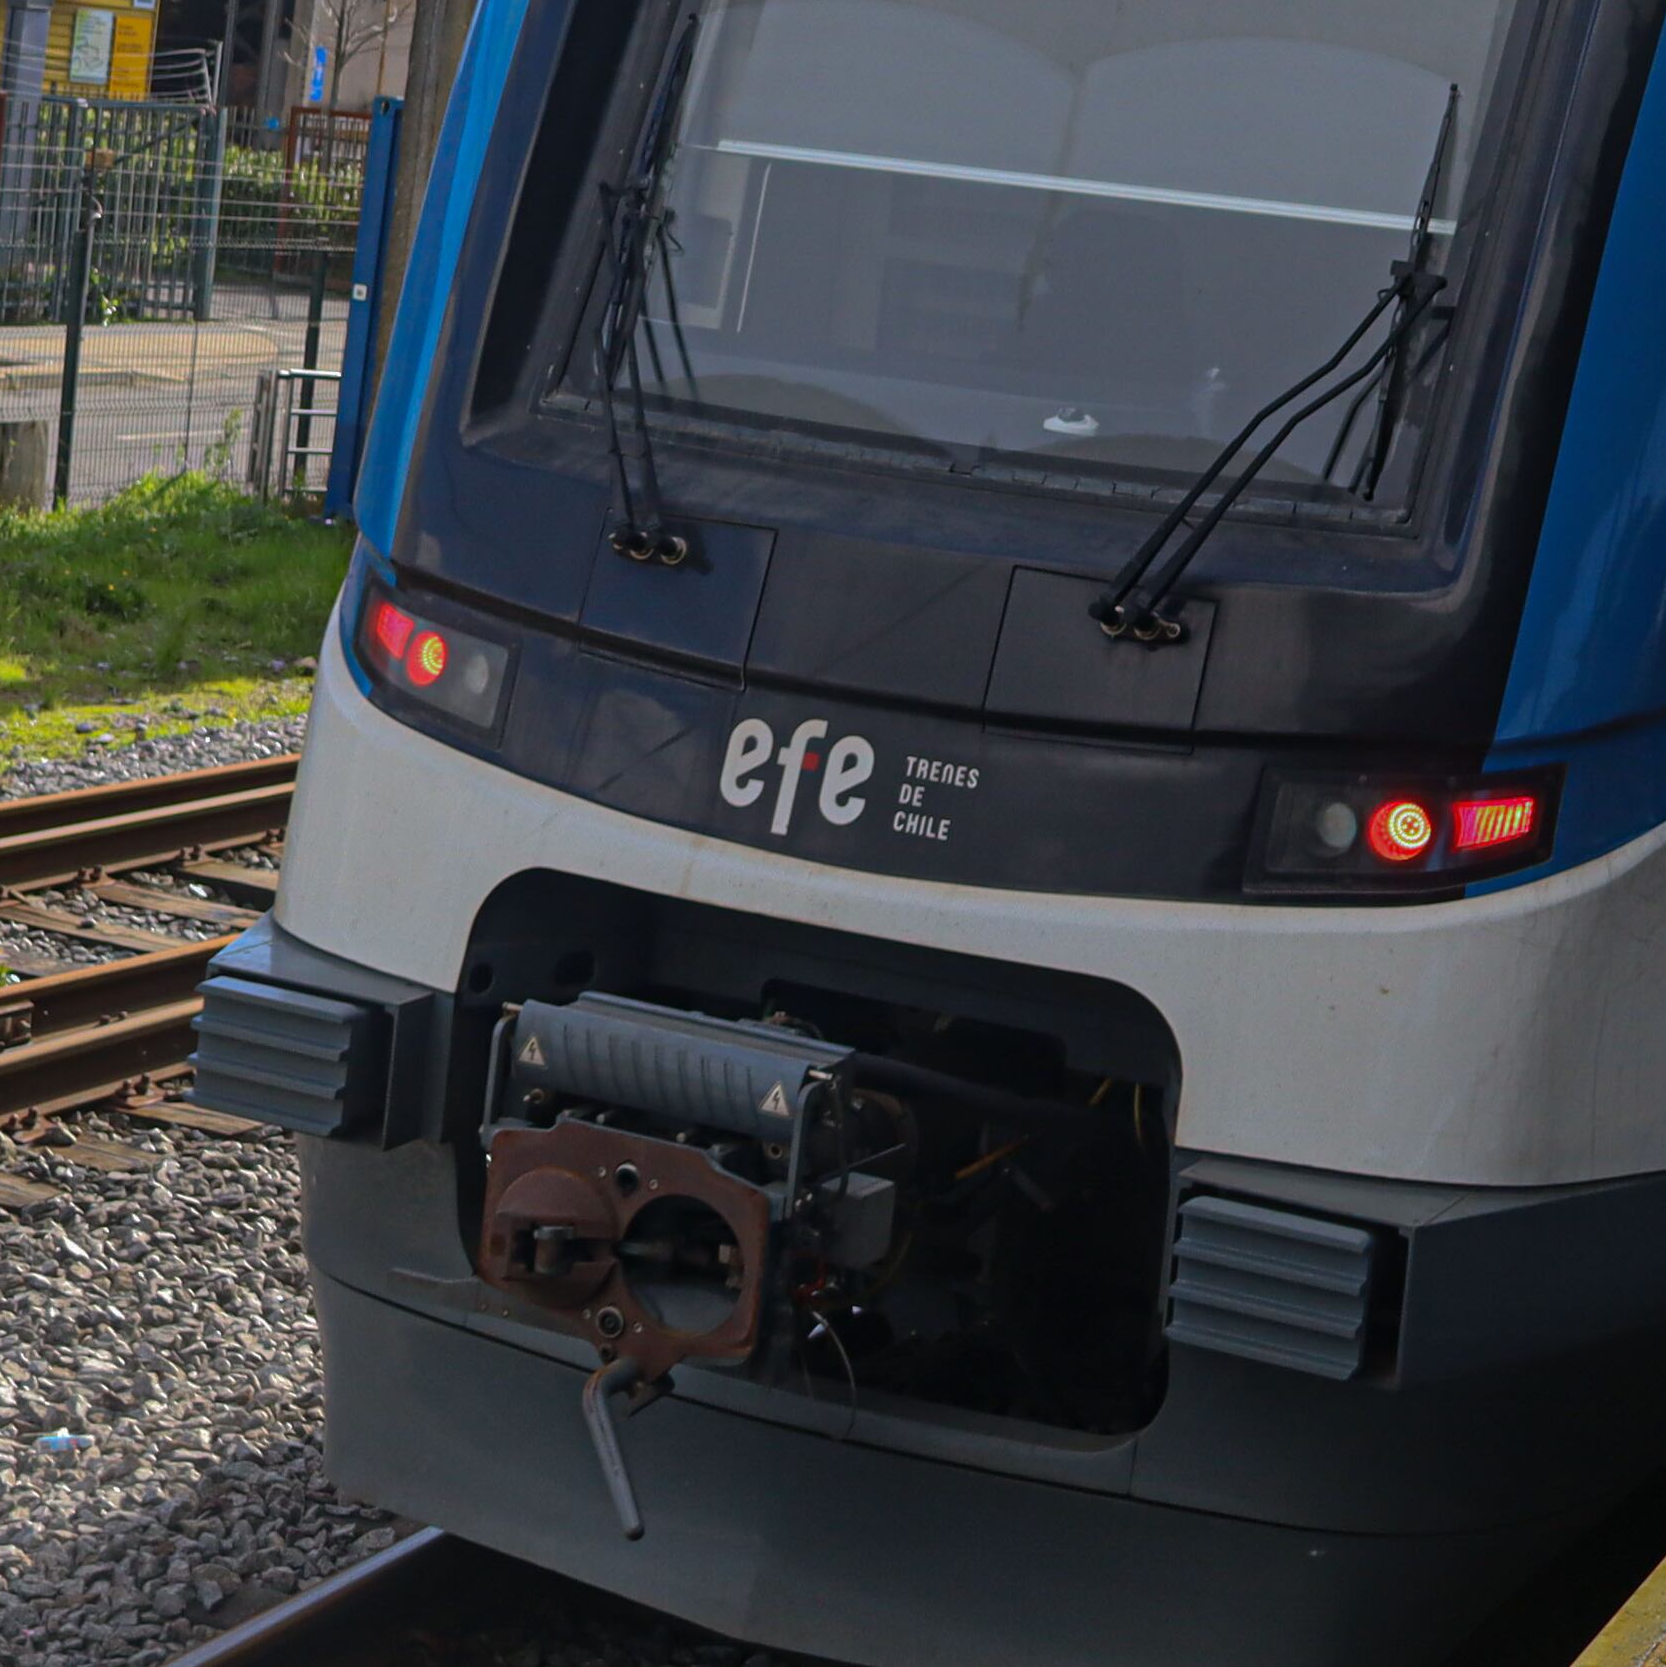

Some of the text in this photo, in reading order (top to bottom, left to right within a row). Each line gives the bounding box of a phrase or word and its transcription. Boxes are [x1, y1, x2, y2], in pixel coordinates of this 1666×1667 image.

[719, 717, 875, 836] efe
[905, 755, 981, 789] TRENES
[898, 783, 926, 808] DE
[892, 810, 952, 841] CHILE
